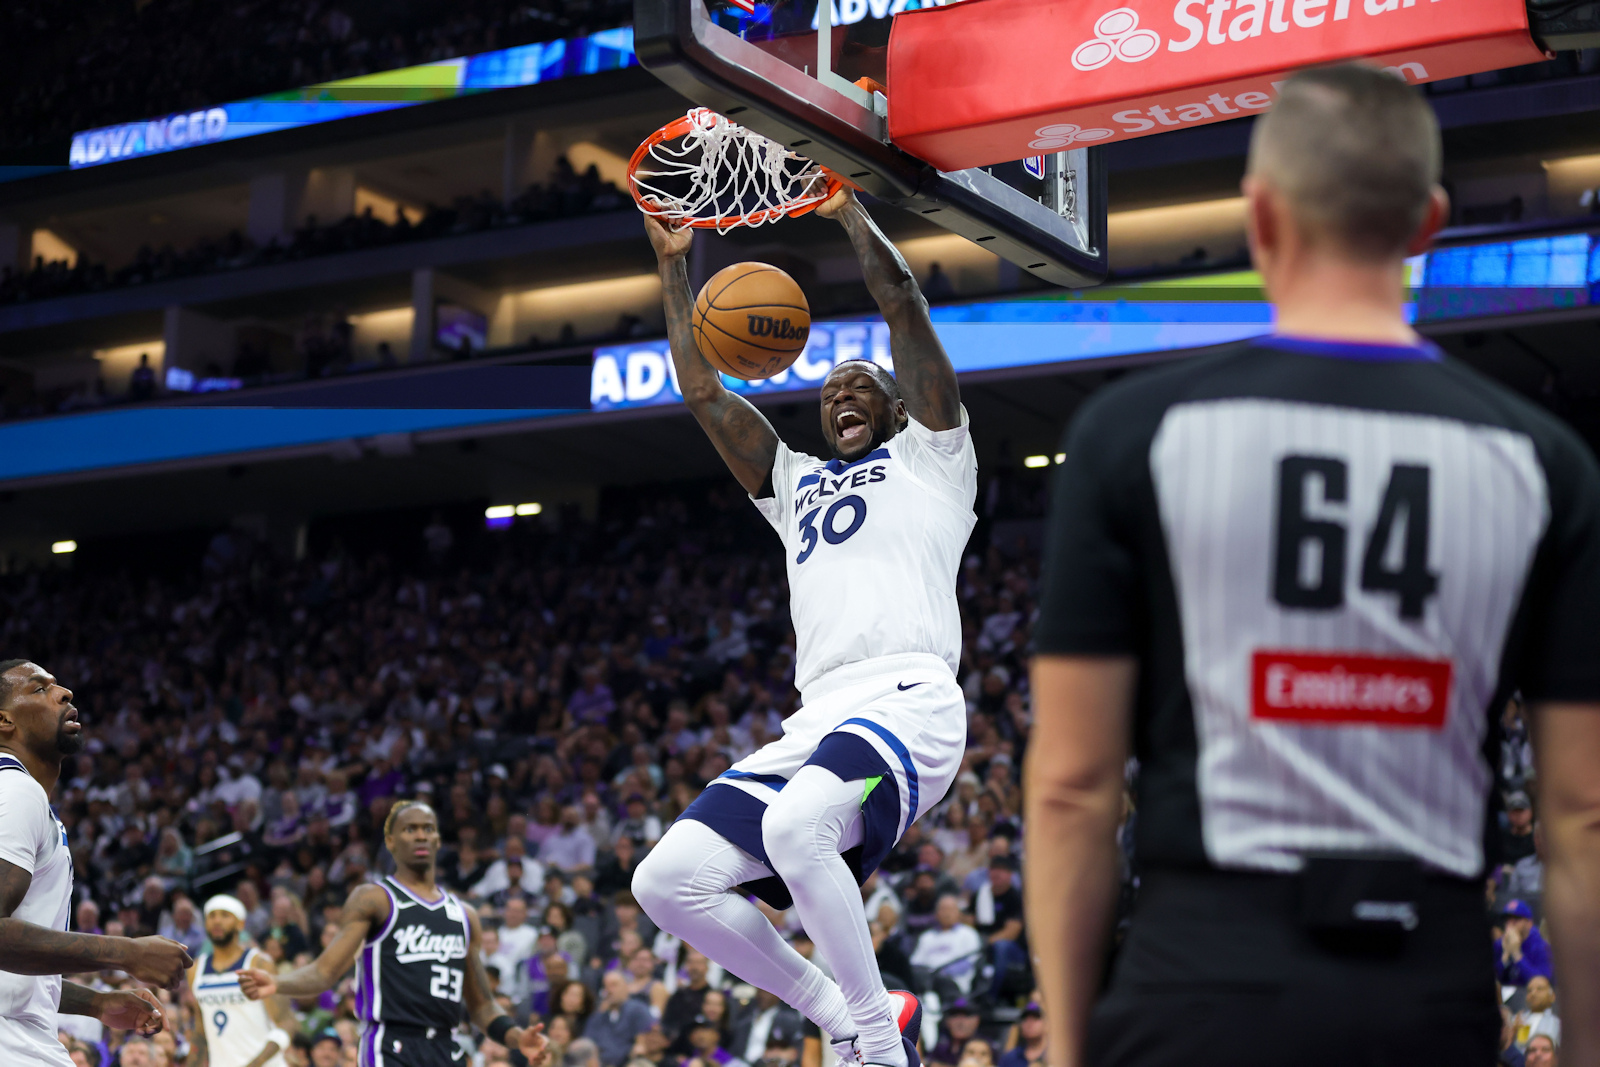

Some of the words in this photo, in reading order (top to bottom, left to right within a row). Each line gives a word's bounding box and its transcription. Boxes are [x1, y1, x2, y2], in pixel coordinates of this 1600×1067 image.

[69, 107, 228, 165] ADVANCED
[796, 494, 867, 565] 30
[1272, 454, 1441, 621] 64
[1264, 661, 1434, 714] Emirates
[393, 924, 467, 964] Kings
[430, 964, 464, 1003] 23
[213, 1010, 228, 1037] 9
